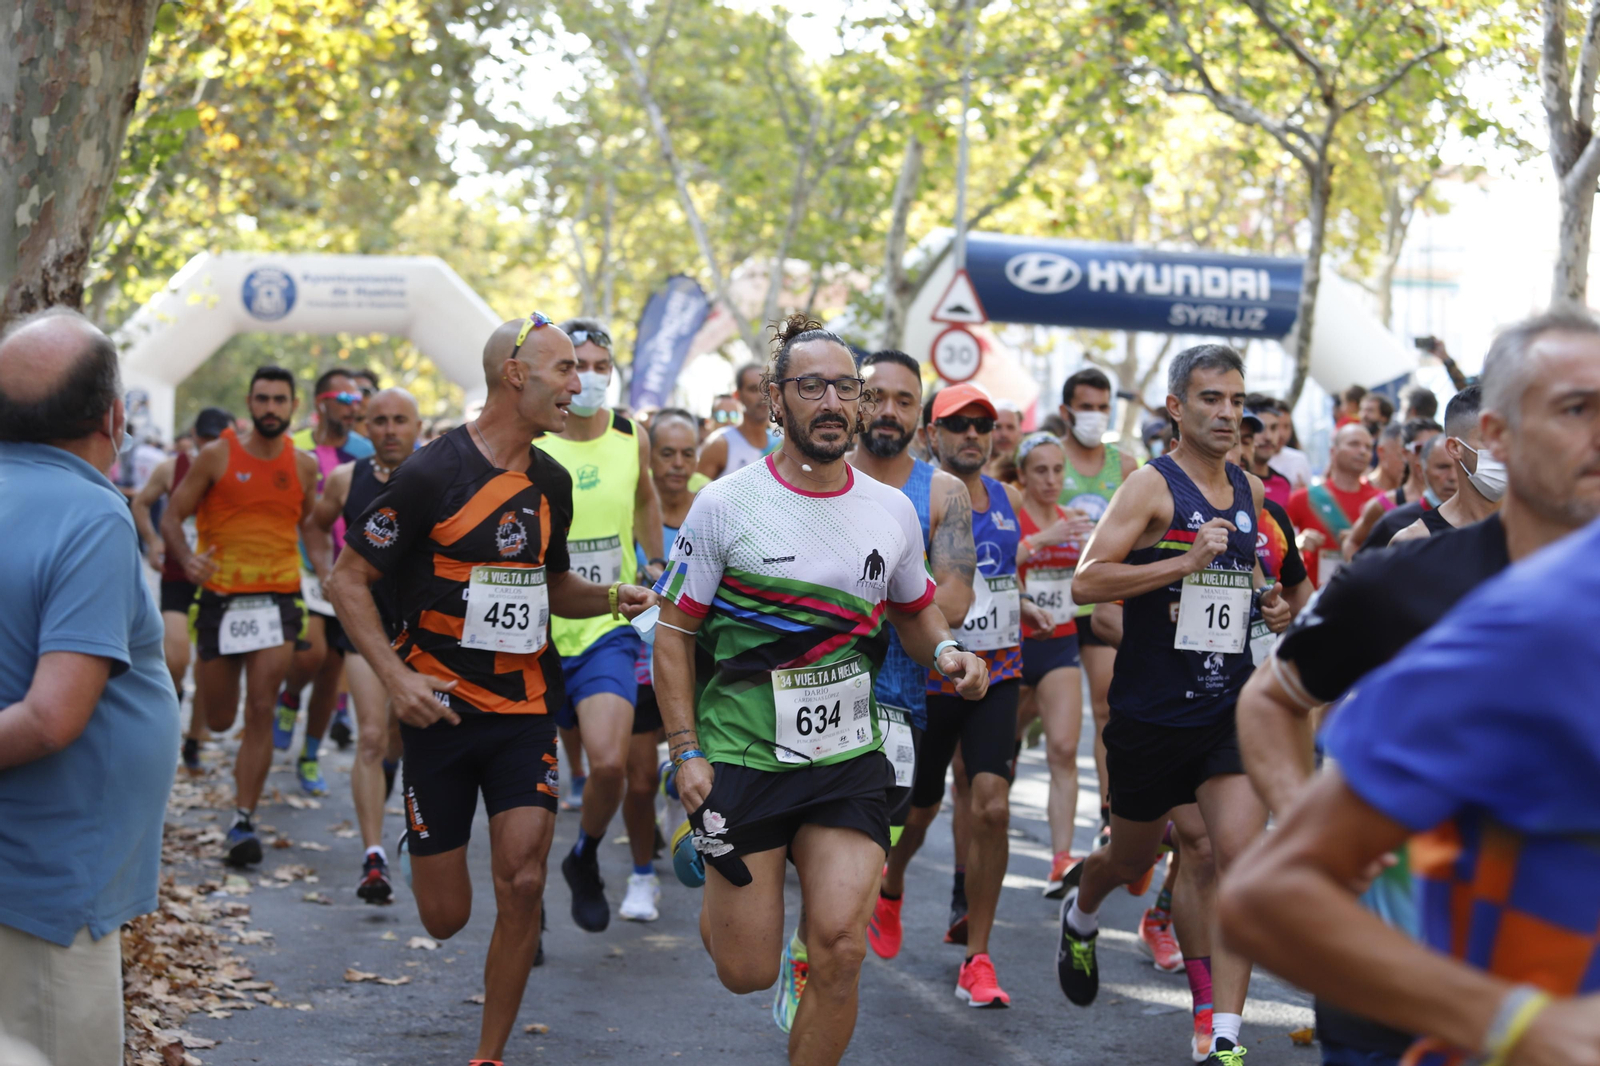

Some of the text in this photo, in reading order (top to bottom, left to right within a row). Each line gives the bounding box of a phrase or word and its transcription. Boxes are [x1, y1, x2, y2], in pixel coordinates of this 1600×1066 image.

[1087, 259, 1270, 301] HYUNDAI
[1168, 303, 1268, 330] SYRLUZ
[943, 344, 972, 365] 30
[478, 570, 489, 582] 34
[491, 571, 521, 585] VUELTA
[523, 573, 530, 585] A
[570, 565, 601, 584] 36
[1190, 573, 1200, 584] 34
[1202, 573, 1229, 586] VUELTA
[1229, 575, 1235, 587] A
[494, 587, 522, 595] CARLOS
[1204, 588, 1229, 596] MANUEL
[1037, 592, 1063, 609] 645
[484, 602, 530, 631] 453
[1205, 603, 1230, 630] 16
[230, 620, 259, 638] 606
[780, 661, 861, 688] 34 VUELTA A HUELVA
[805, 687, 829, 697] DARÍO
[825, 692, 840, 701] LÓPEZ
[796, 700, 841, 736] 634
